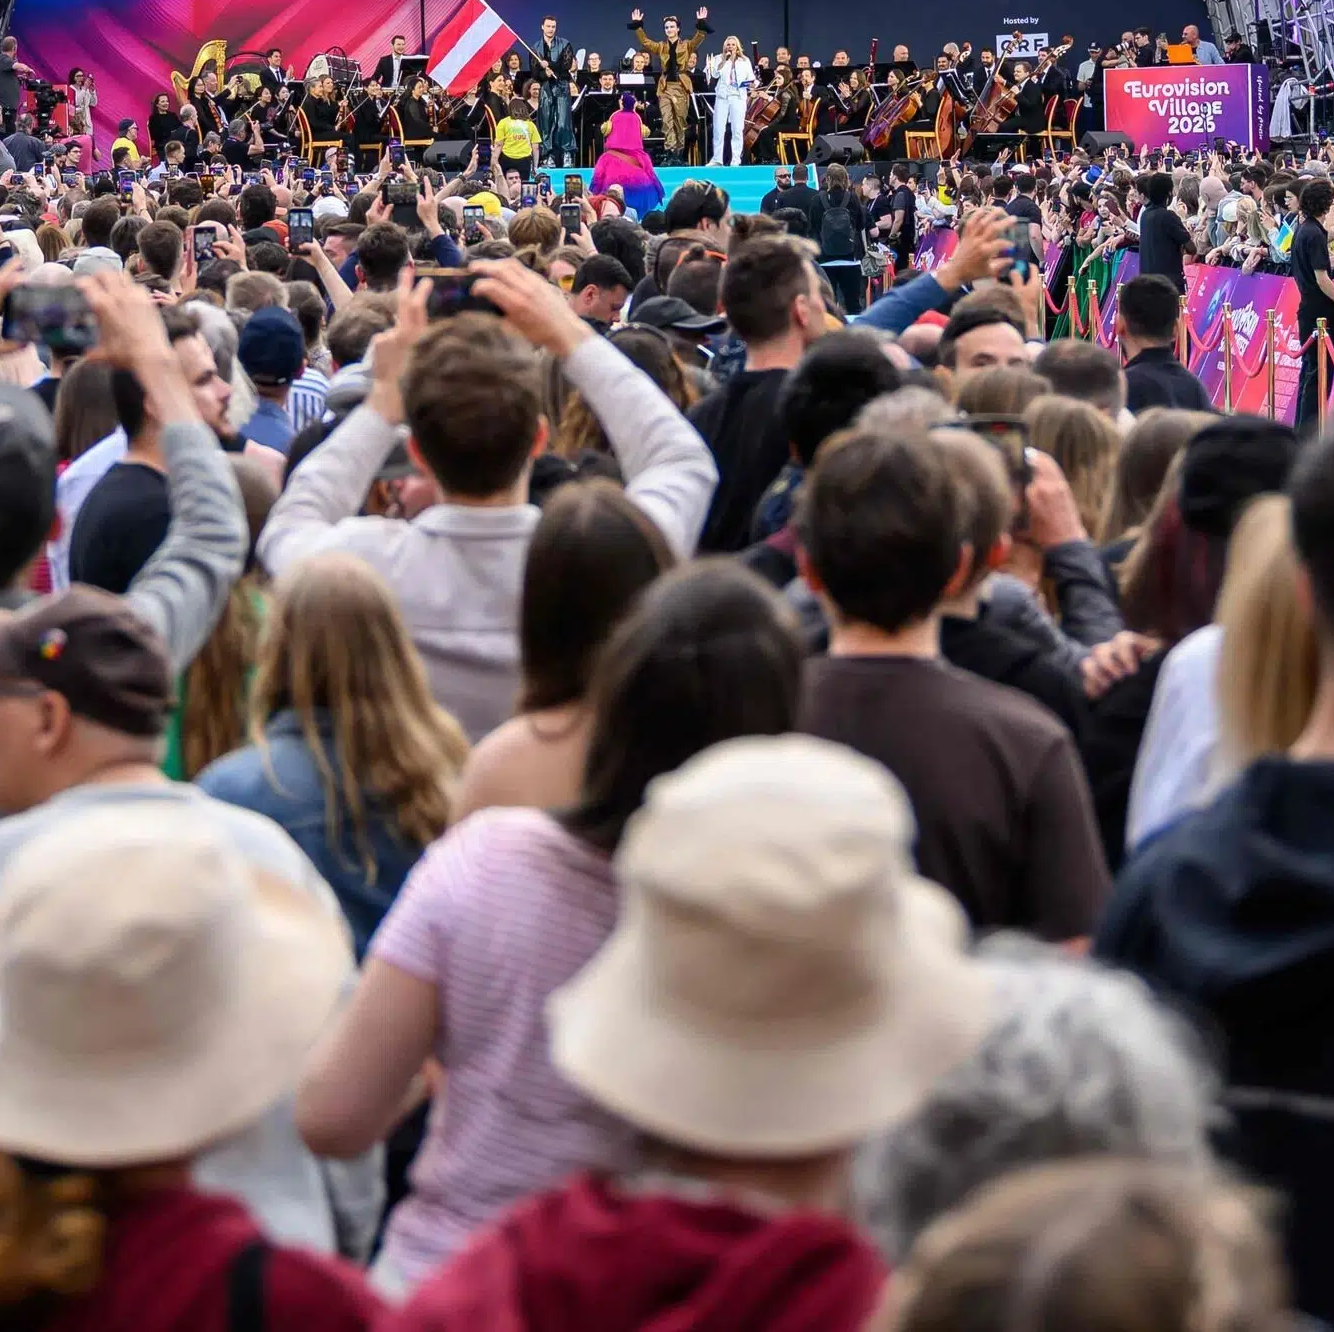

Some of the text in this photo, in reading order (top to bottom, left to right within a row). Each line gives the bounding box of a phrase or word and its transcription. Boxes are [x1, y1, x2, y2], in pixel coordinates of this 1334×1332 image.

[1029, 16, 1039, 24] by
[1123, 78, 1230, 98] Eurovision
[1148, 98, 1223, 117] Village
[1168, 116, 1216, 134] 2026
